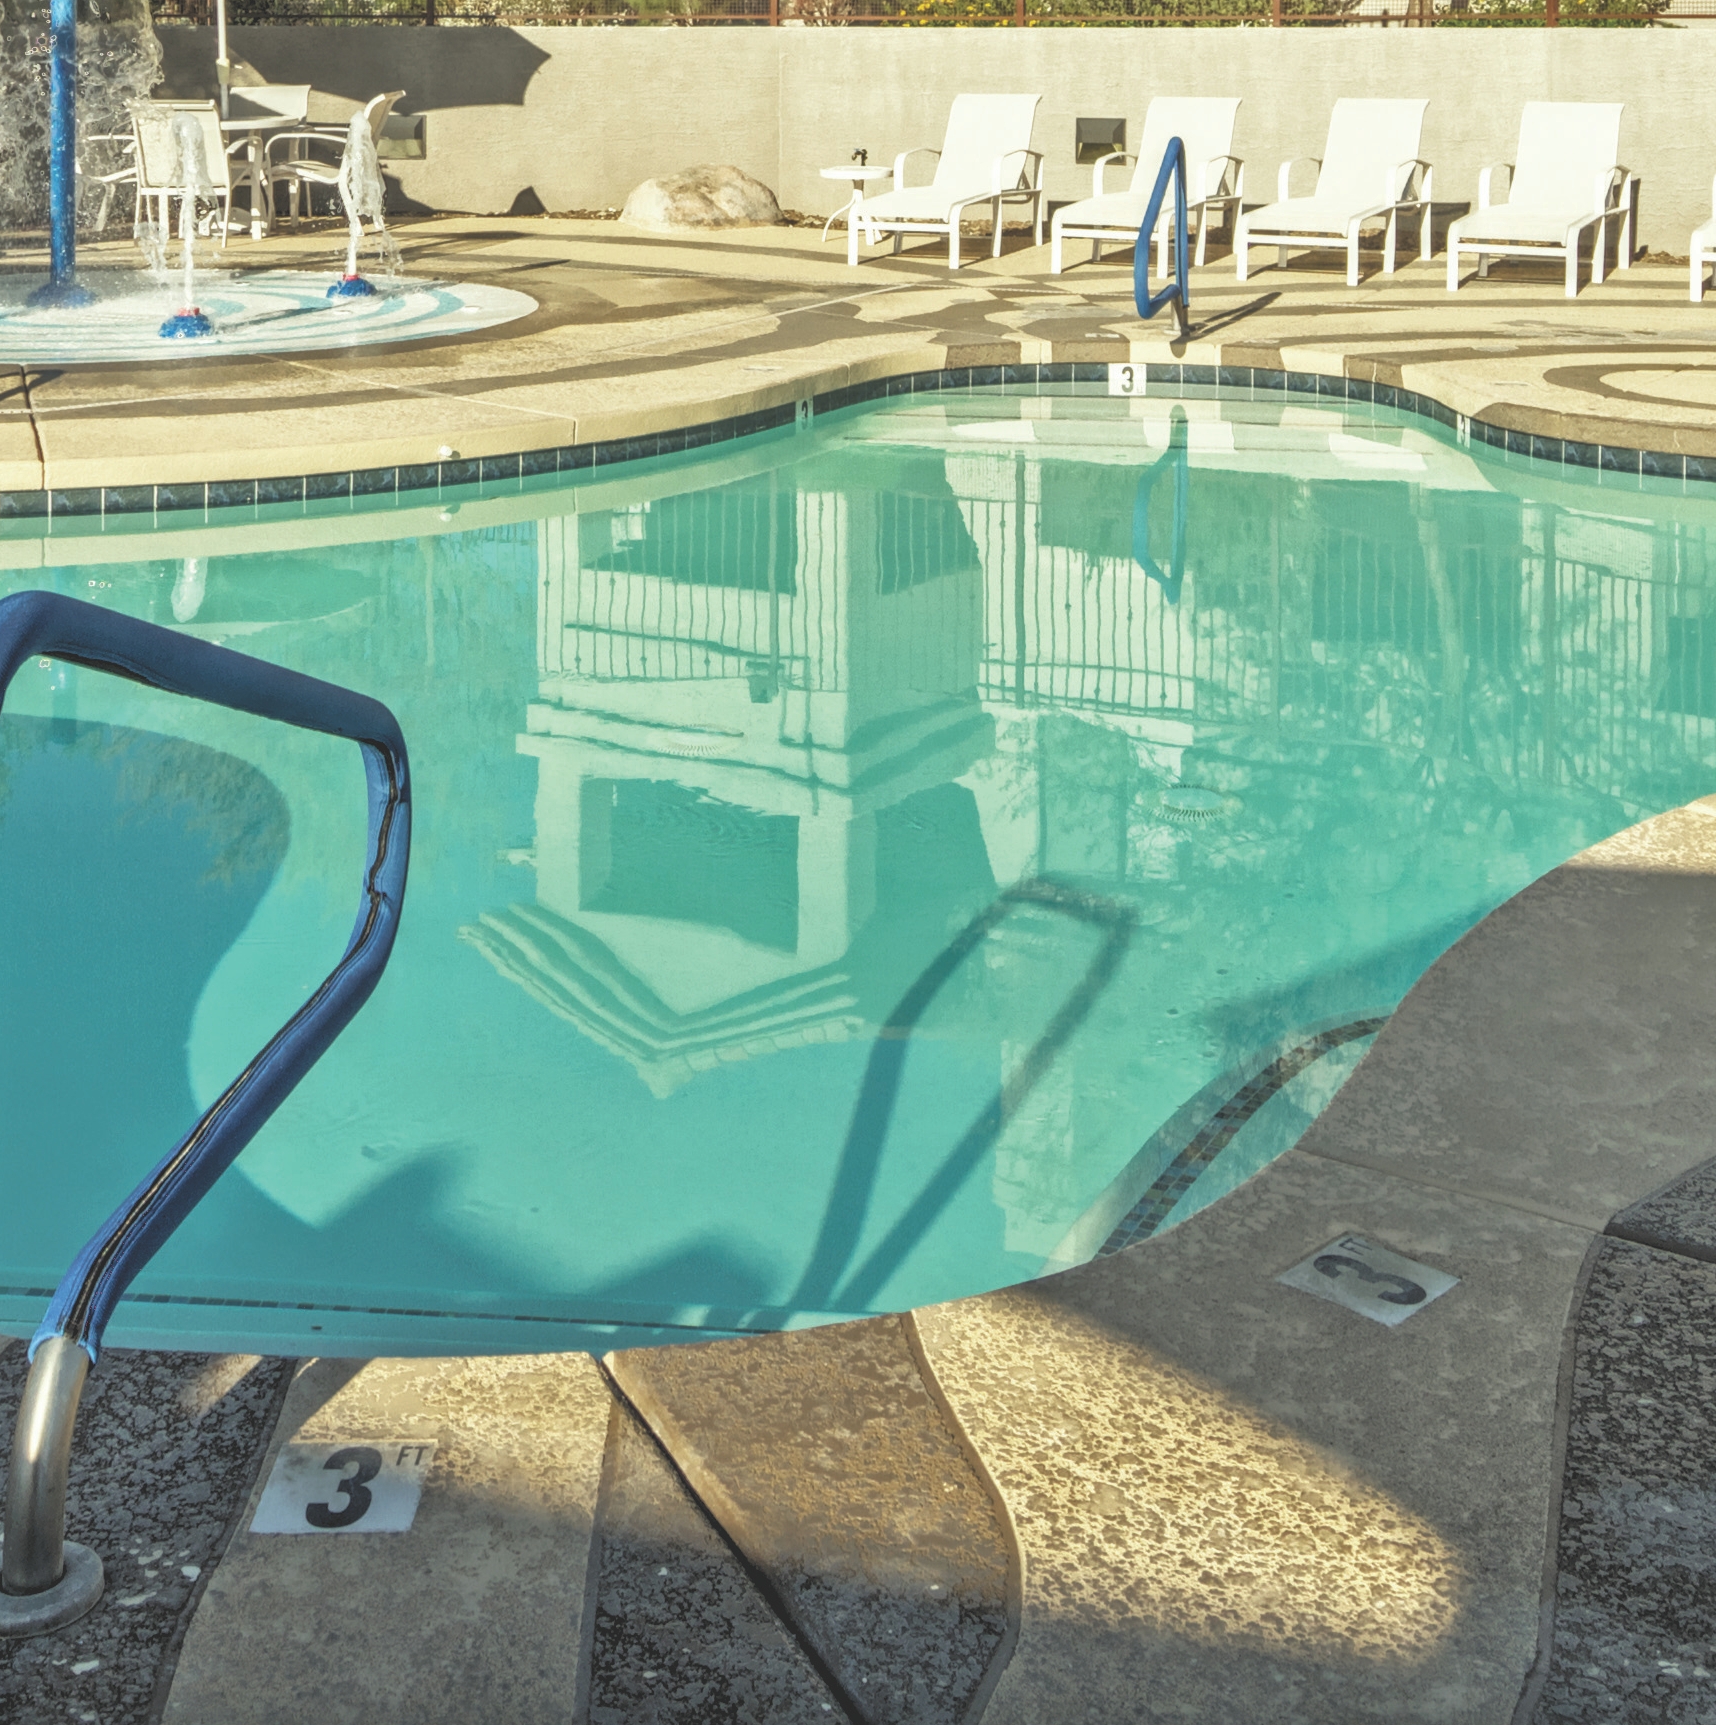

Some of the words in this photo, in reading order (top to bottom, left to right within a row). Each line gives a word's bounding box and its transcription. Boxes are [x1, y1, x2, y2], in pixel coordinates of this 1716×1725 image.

[1121, 366, 1134, 392] 3
[1338, 1237, 1372, 1256] FT
[1313, 1254, 1427, 1305] 3
[306, 1446, 382, 1528] 3
[396, 1446, 429, 1466] FT
